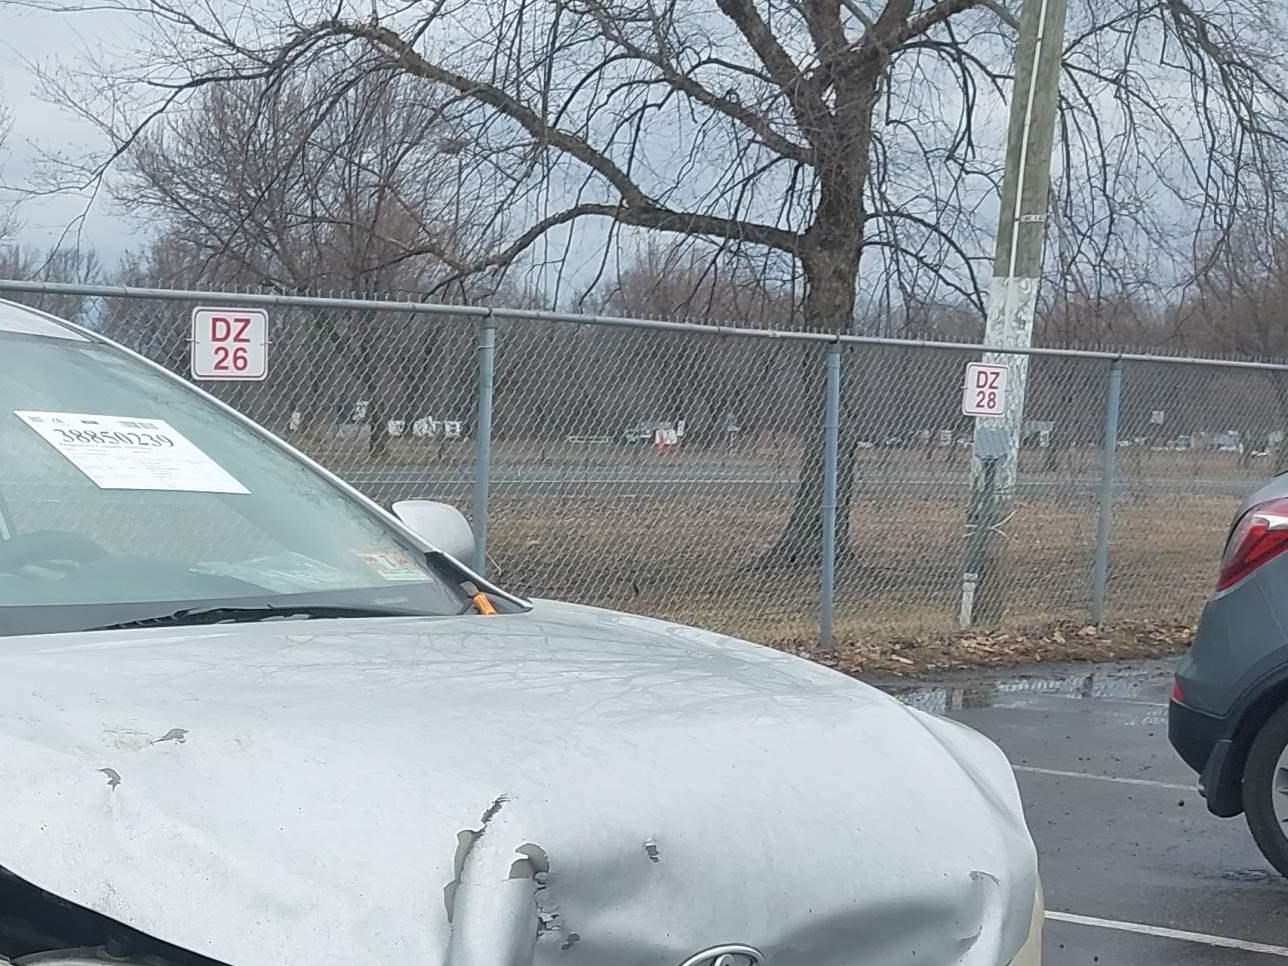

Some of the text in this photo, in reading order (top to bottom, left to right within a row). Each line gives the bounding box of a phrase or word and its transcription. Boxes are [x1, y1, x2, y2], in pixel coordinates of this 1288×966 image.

[211, 317, 251, 343] DZ
[213, 346, 248, 371] 26
[976, 370, 1000, 389] DZ
[975, 390, 996, 409] 28
[53, 428, 174, 448] 38850239
